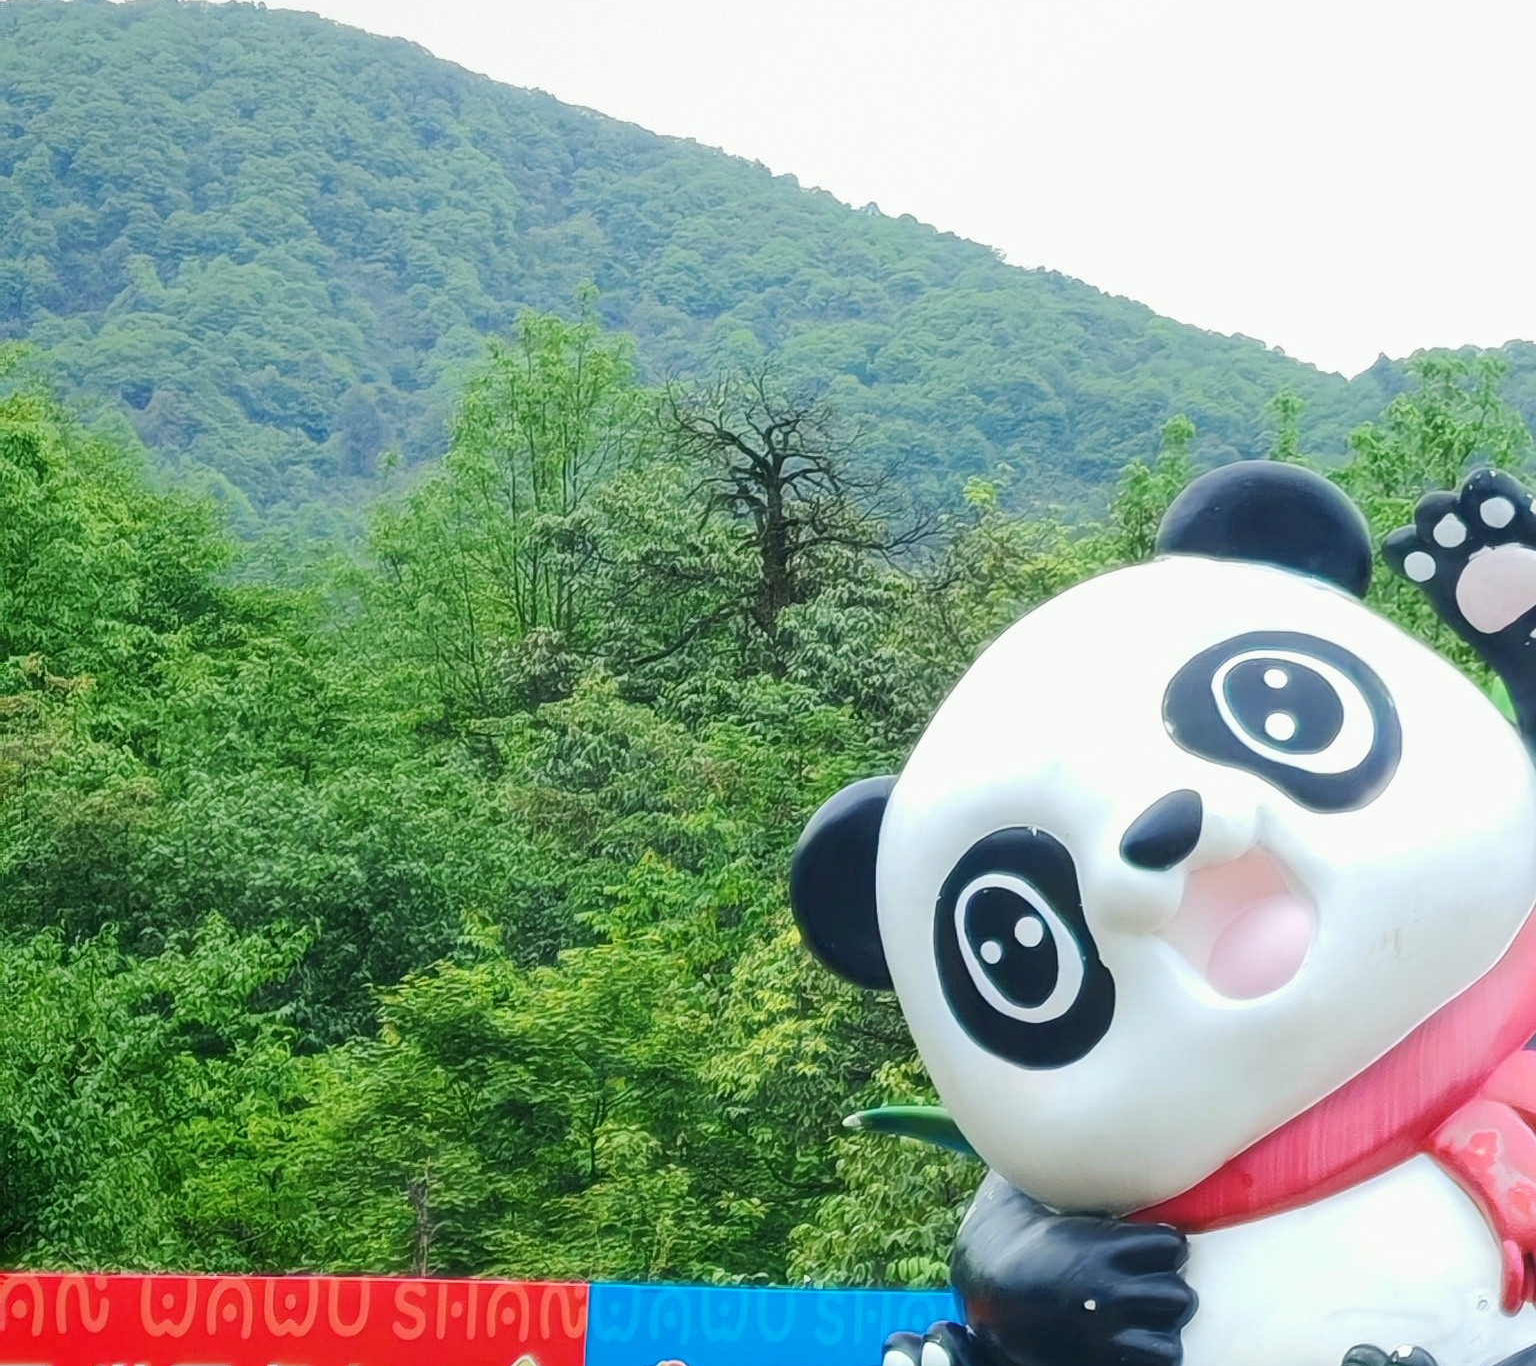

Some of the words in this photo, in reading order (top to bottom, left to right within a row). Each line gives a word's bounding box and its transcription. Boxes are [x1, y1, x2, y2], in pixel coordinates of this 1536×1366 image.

[140, 1277, 371, 1339] WAWU
[392, 1282, 588, 1343] SHAN
[814, 1292, 958, 1345] SHA
